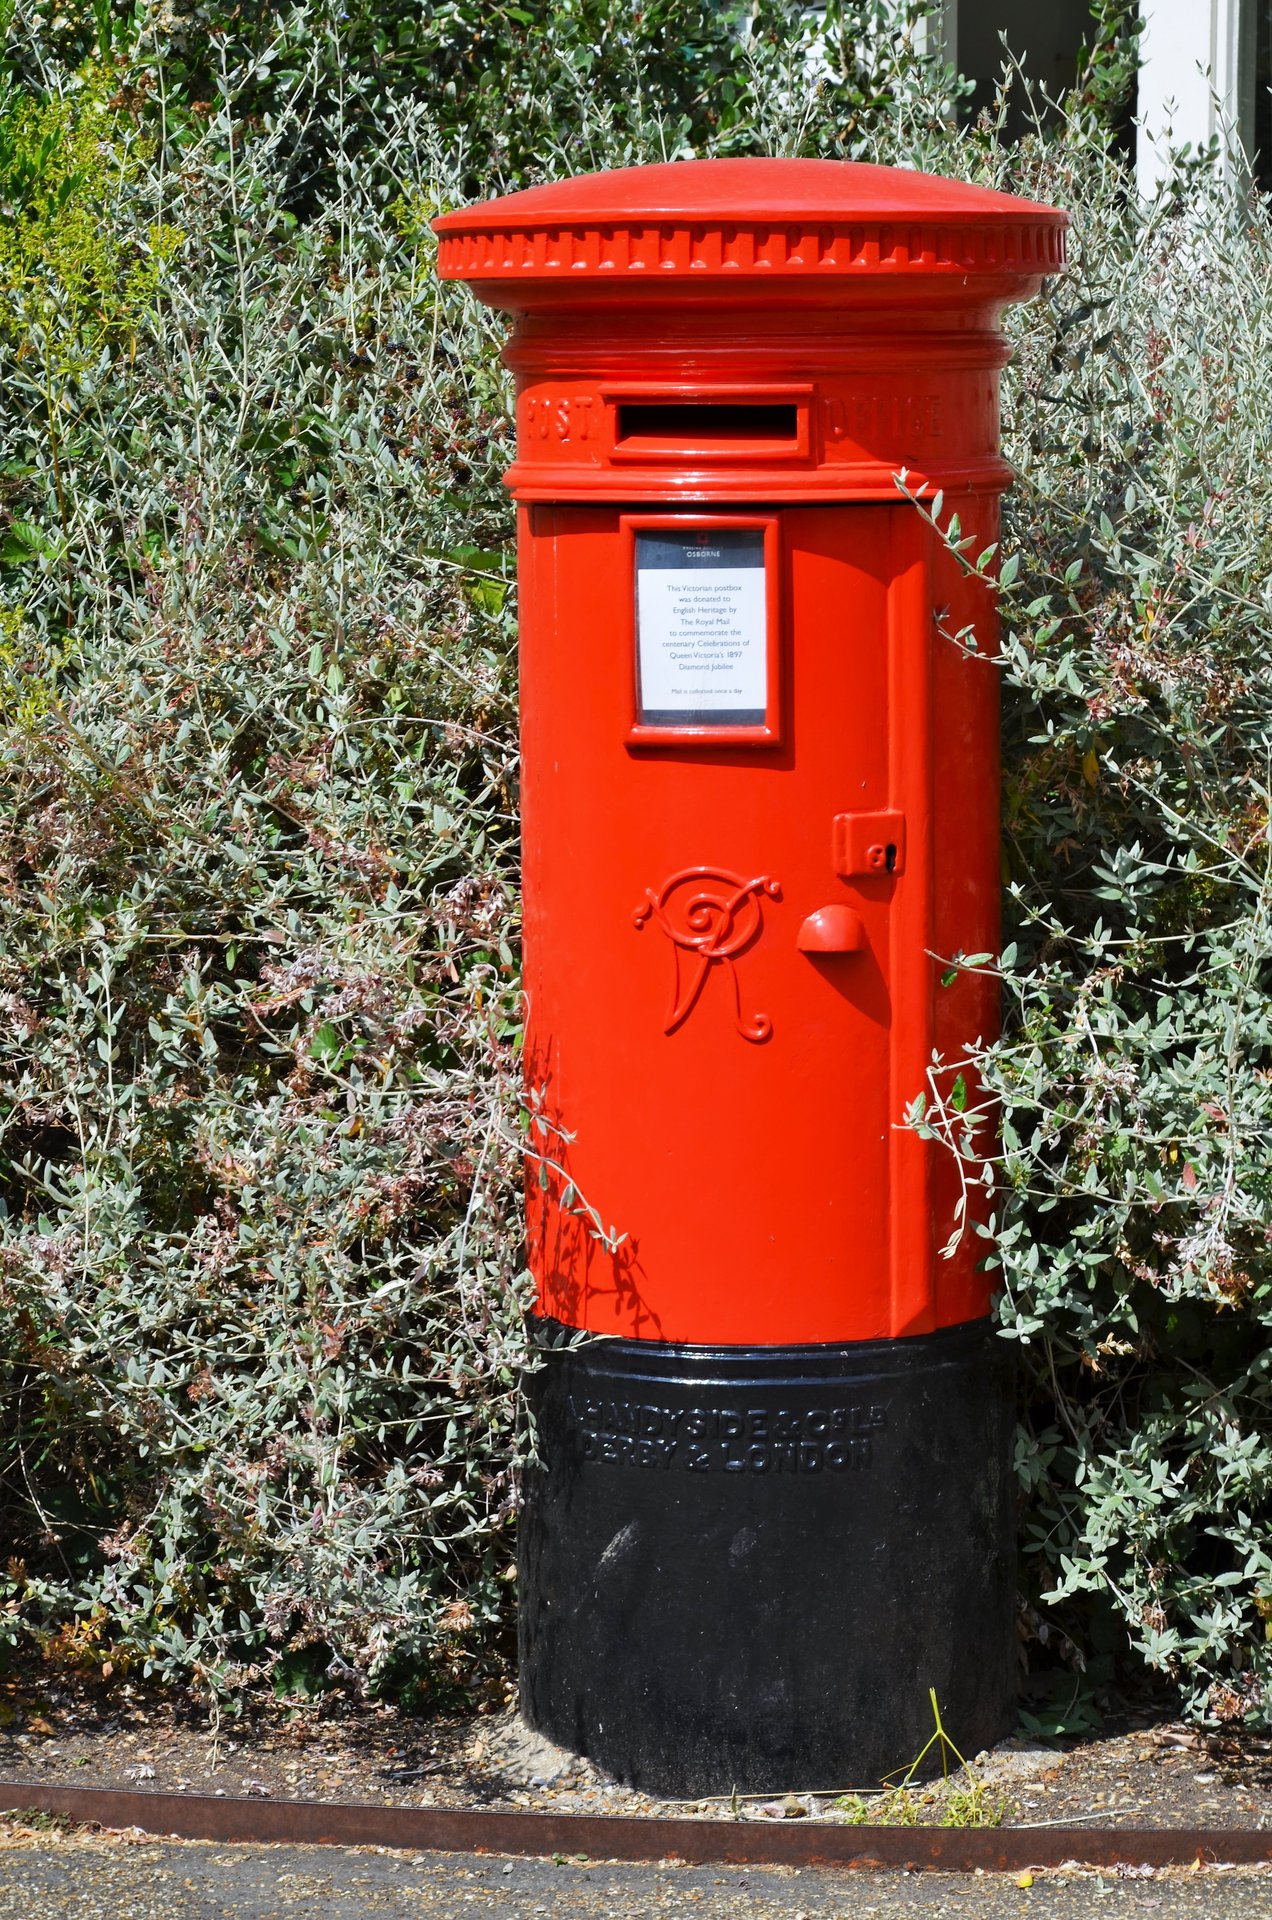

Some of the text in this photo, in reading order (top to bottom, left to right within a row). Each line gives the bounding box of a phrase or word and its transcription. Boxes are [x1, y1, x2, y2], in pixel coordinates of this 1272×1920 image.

[686, 550, 721, 558] OSBORNE
[681, 584, 713, 592] Victorian
[714, 584, 742, 593] postbox
[673, 606, 738, 616] English Heritage by
[681, 618, 730, 627] The Royal Mail
[679, 629, 729, 637] commemorate
[730, 628, 742, 636] the
[662, 639, 750, 649] centenary Celebrations of
[669, 650, 743, 660] Queen Victoria's 1897
[679, 662, 734, 672] Diamond Jubilee
[686, 1441, 711, 1474] &
[721, 1439, 874, 1475] LONDON
